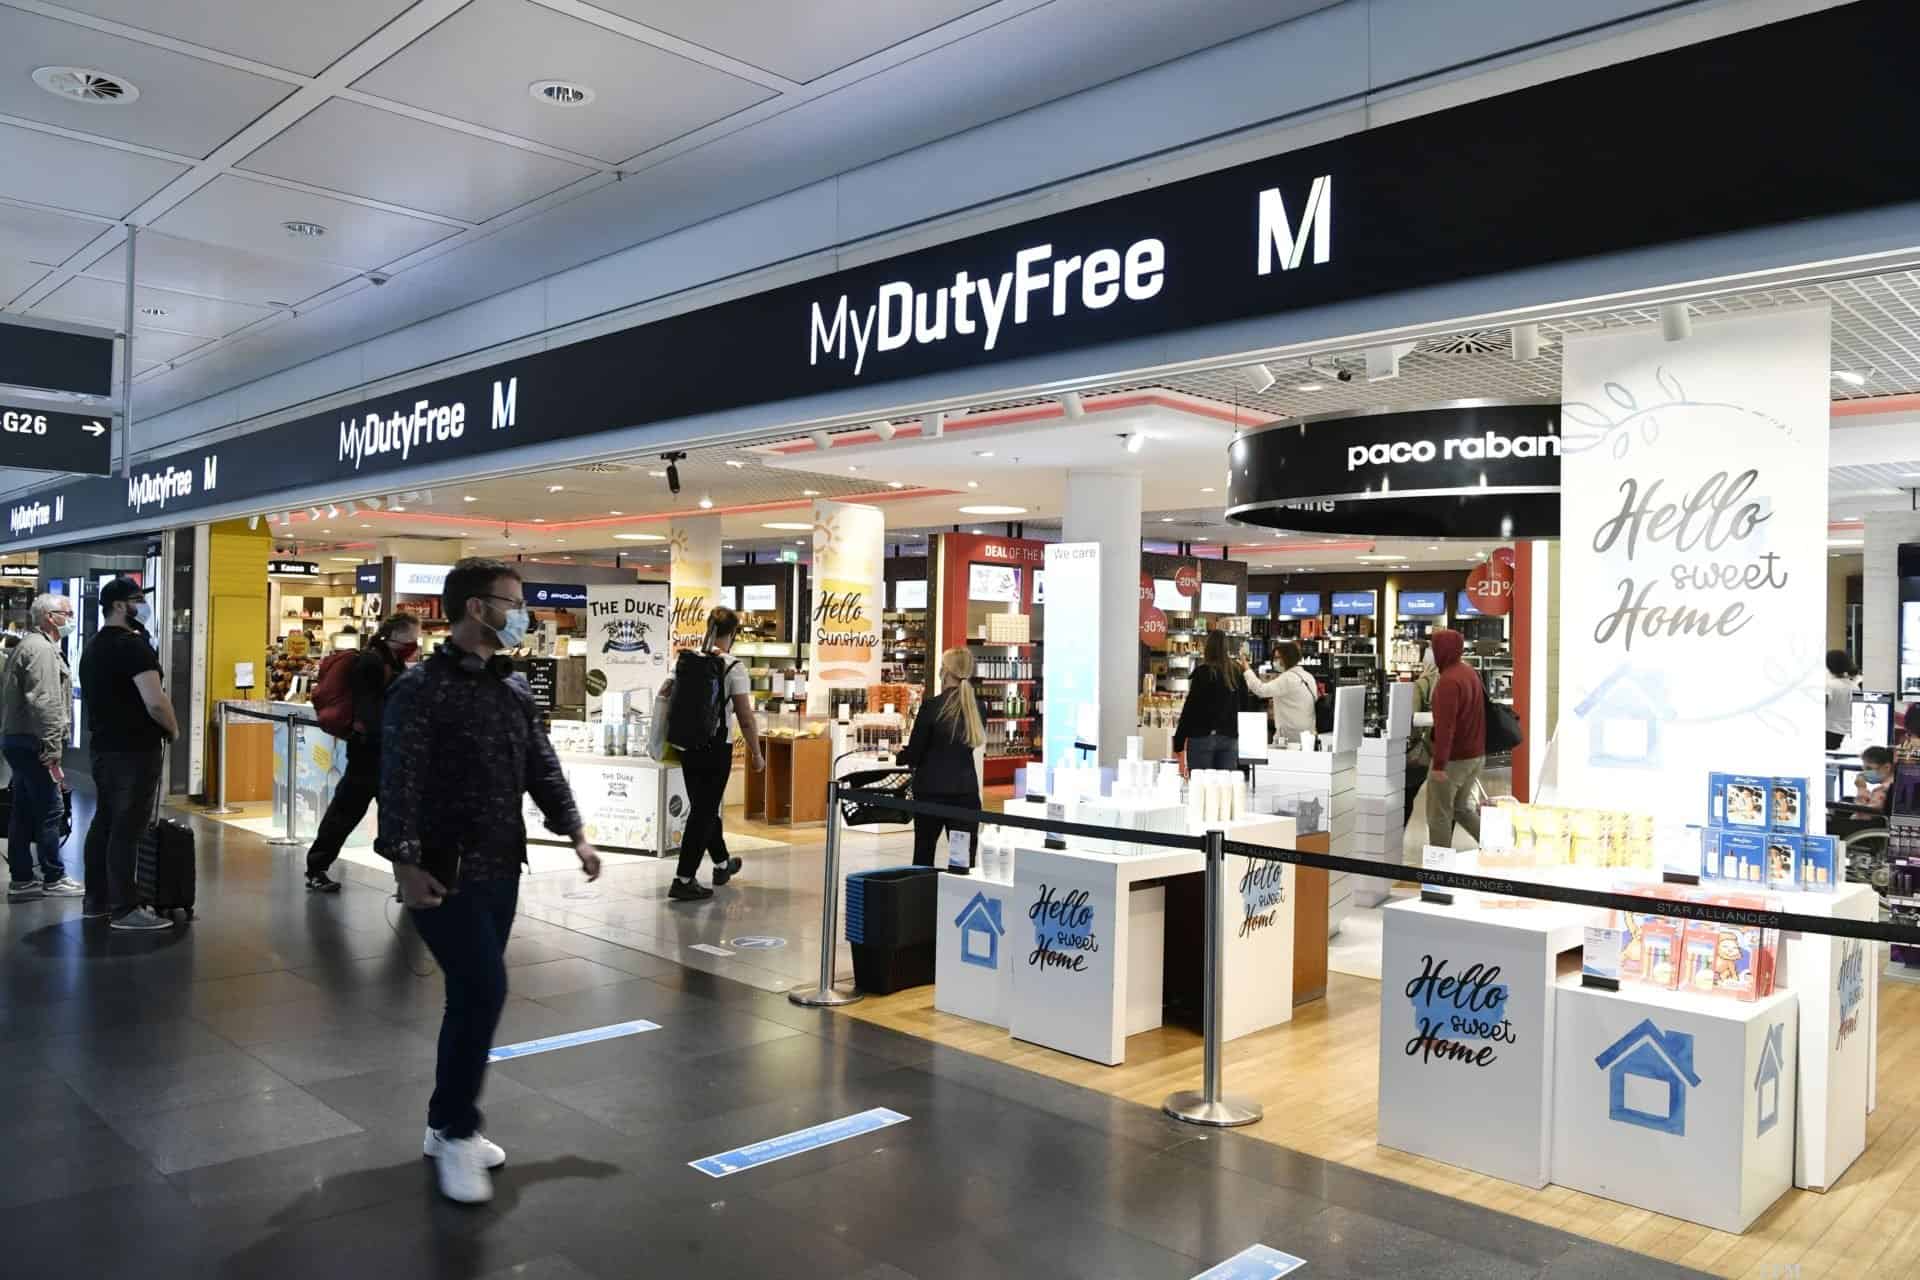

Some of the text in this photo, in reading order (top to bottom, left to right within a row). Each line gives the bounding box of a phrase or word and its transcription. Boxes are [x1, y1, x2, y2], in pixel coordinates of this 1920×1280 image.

[810, 174, 1332, 376] MyDutyFree M
[339, 376, 517, 470] MyDutyFree M
[1347, 431, 1560, 472] paco raban
[128, 455, 217, 515] MyDutyFree M
[10, 495, 64, 536] MyDutyFree M
[1592, 468, 1775, 561] Hello
[985, 544, 1039, 561] DEAL OF THE
[1670, 552, 1788, 590] sweet
[589, 598, 666, 618] THE DUKE
[671, 596, 704, 626] Hello
[814, 590, 864, 626] Hello
[1140, 621, 1166, 633] -30%
[1594, 577, 1754, 652] Home
[816, 627, 880, 648] Sunshine
[1240, 856, 1283, 894] Hello
[1415, 871, 1505, 892] STAR ALLIANCE
[1029, 884, 1094, 928] Hello
[1258, 887, 1286, 907] sweet
[1655, 902, 1767, 925] STAR ALLIANCE
[1239, 903, 1277, 939] Home
[1029, 933, 1088, 973] Home
[1057, 931, 1099, 952] sweet
[1405, 954, 1509, 1012] Hello
[1405, 1017, 1498, 1067] Home
[1450, 1015, 1516, 1044] sweet
